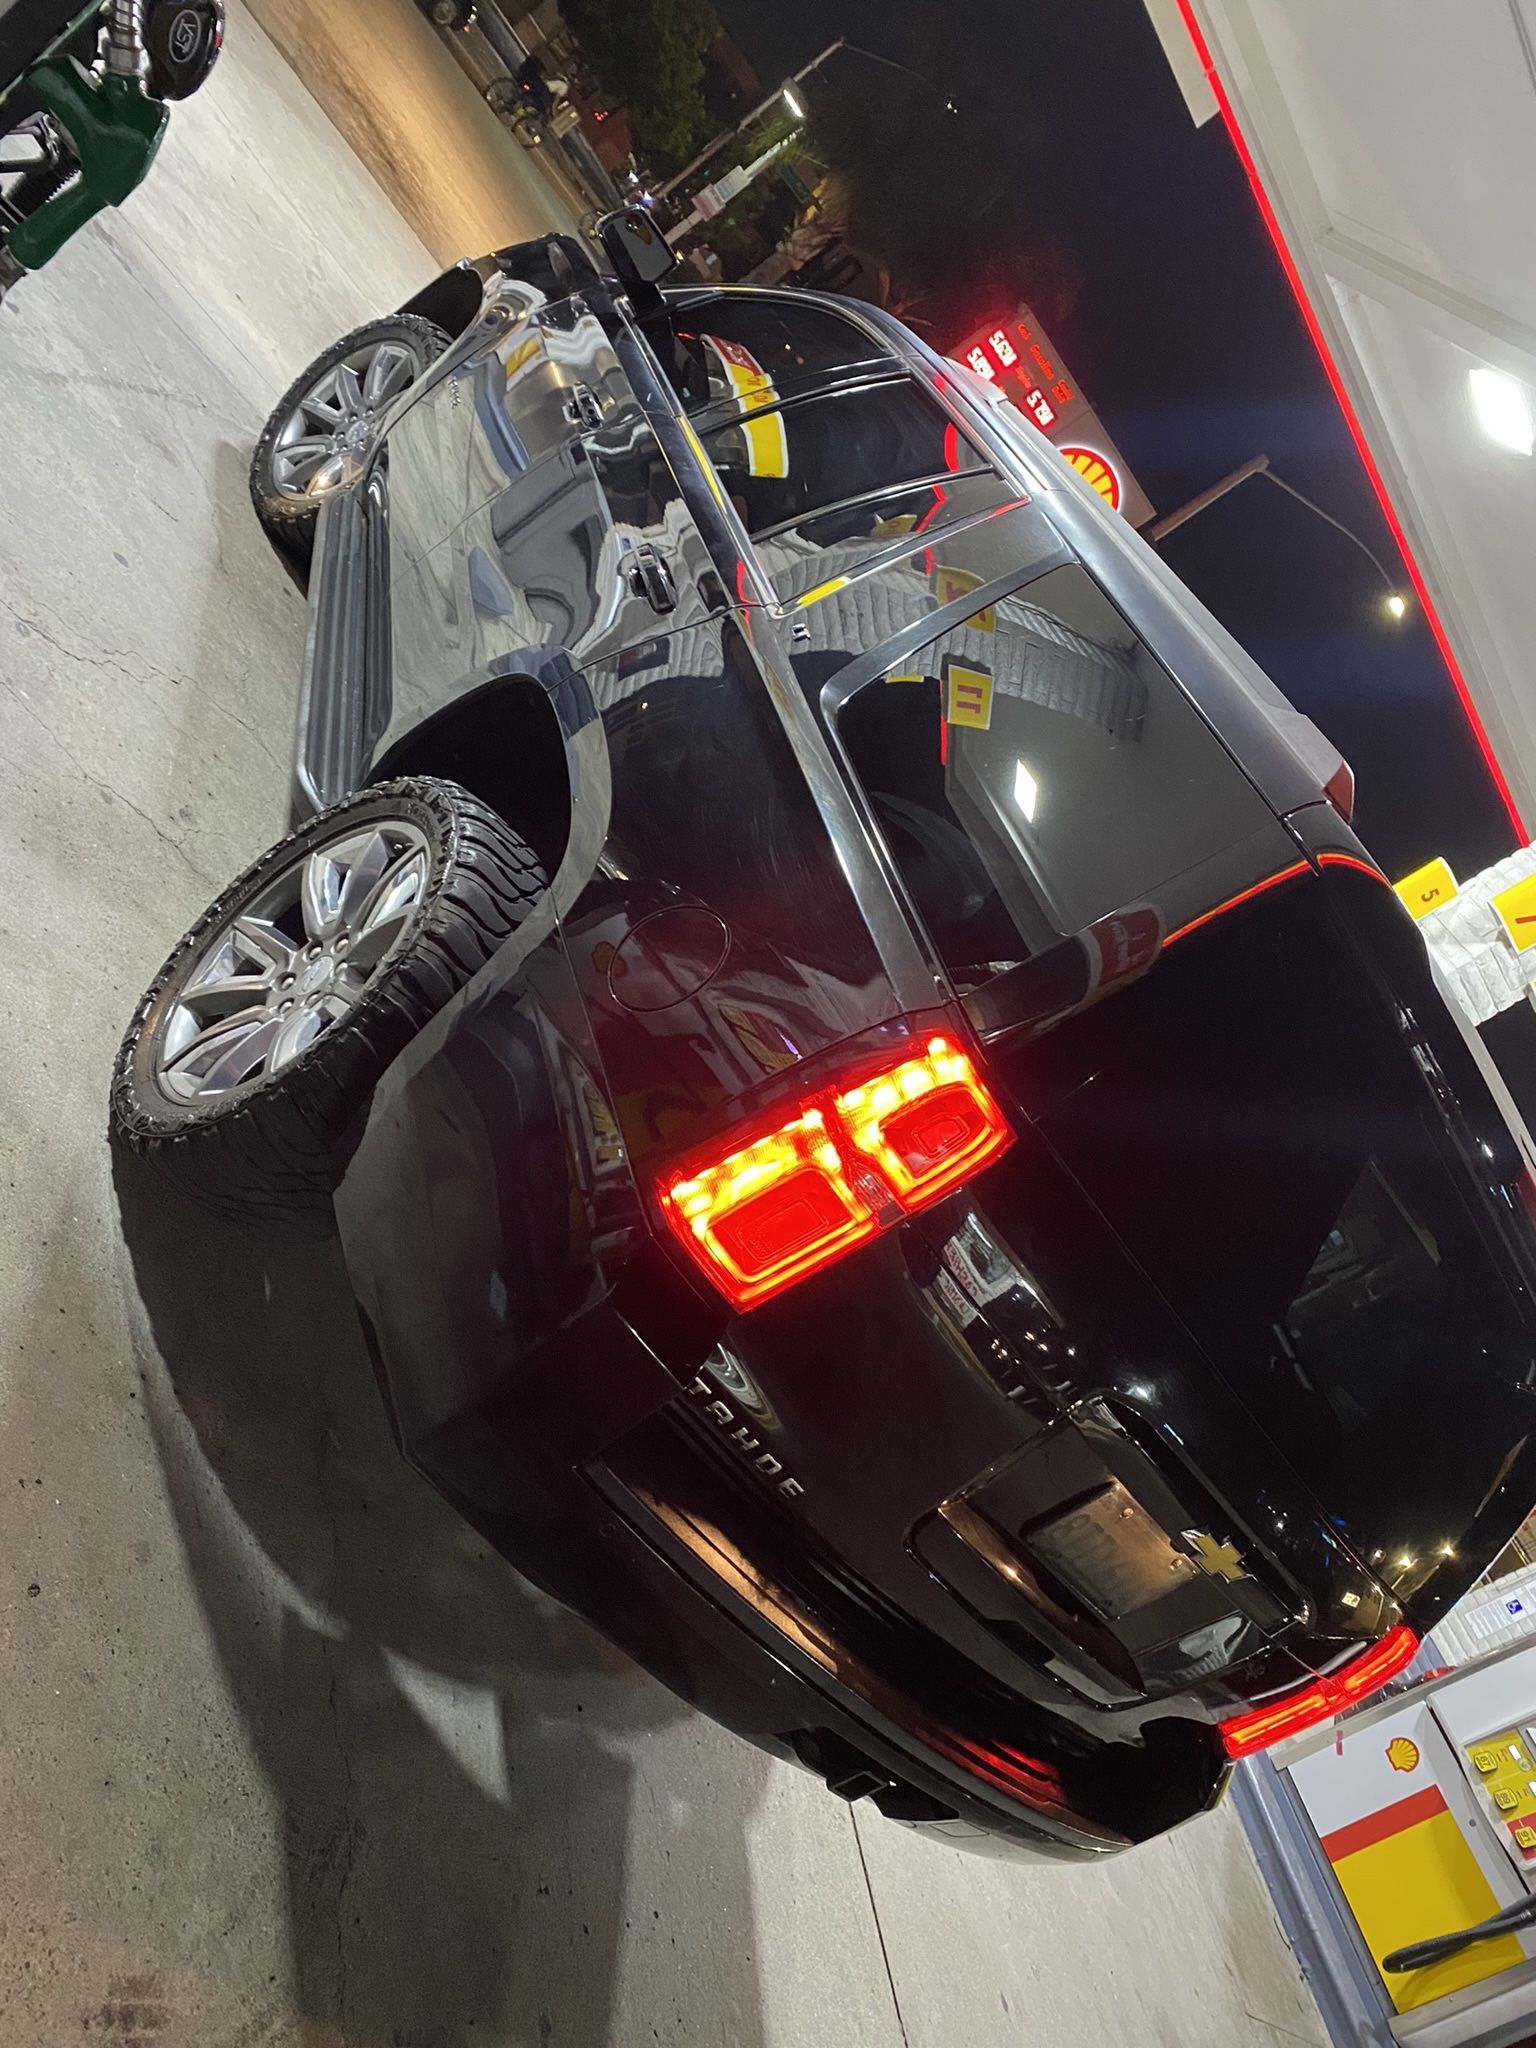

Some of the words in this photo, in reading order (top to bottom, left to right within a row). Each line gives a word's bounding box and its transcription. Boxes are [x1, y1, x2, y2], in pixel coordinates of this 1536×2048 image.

[175, 18, 196, 53] VST
[1421, 888, 1440, 902] 5
[688, 1376, 805, 1498] TAHOE
